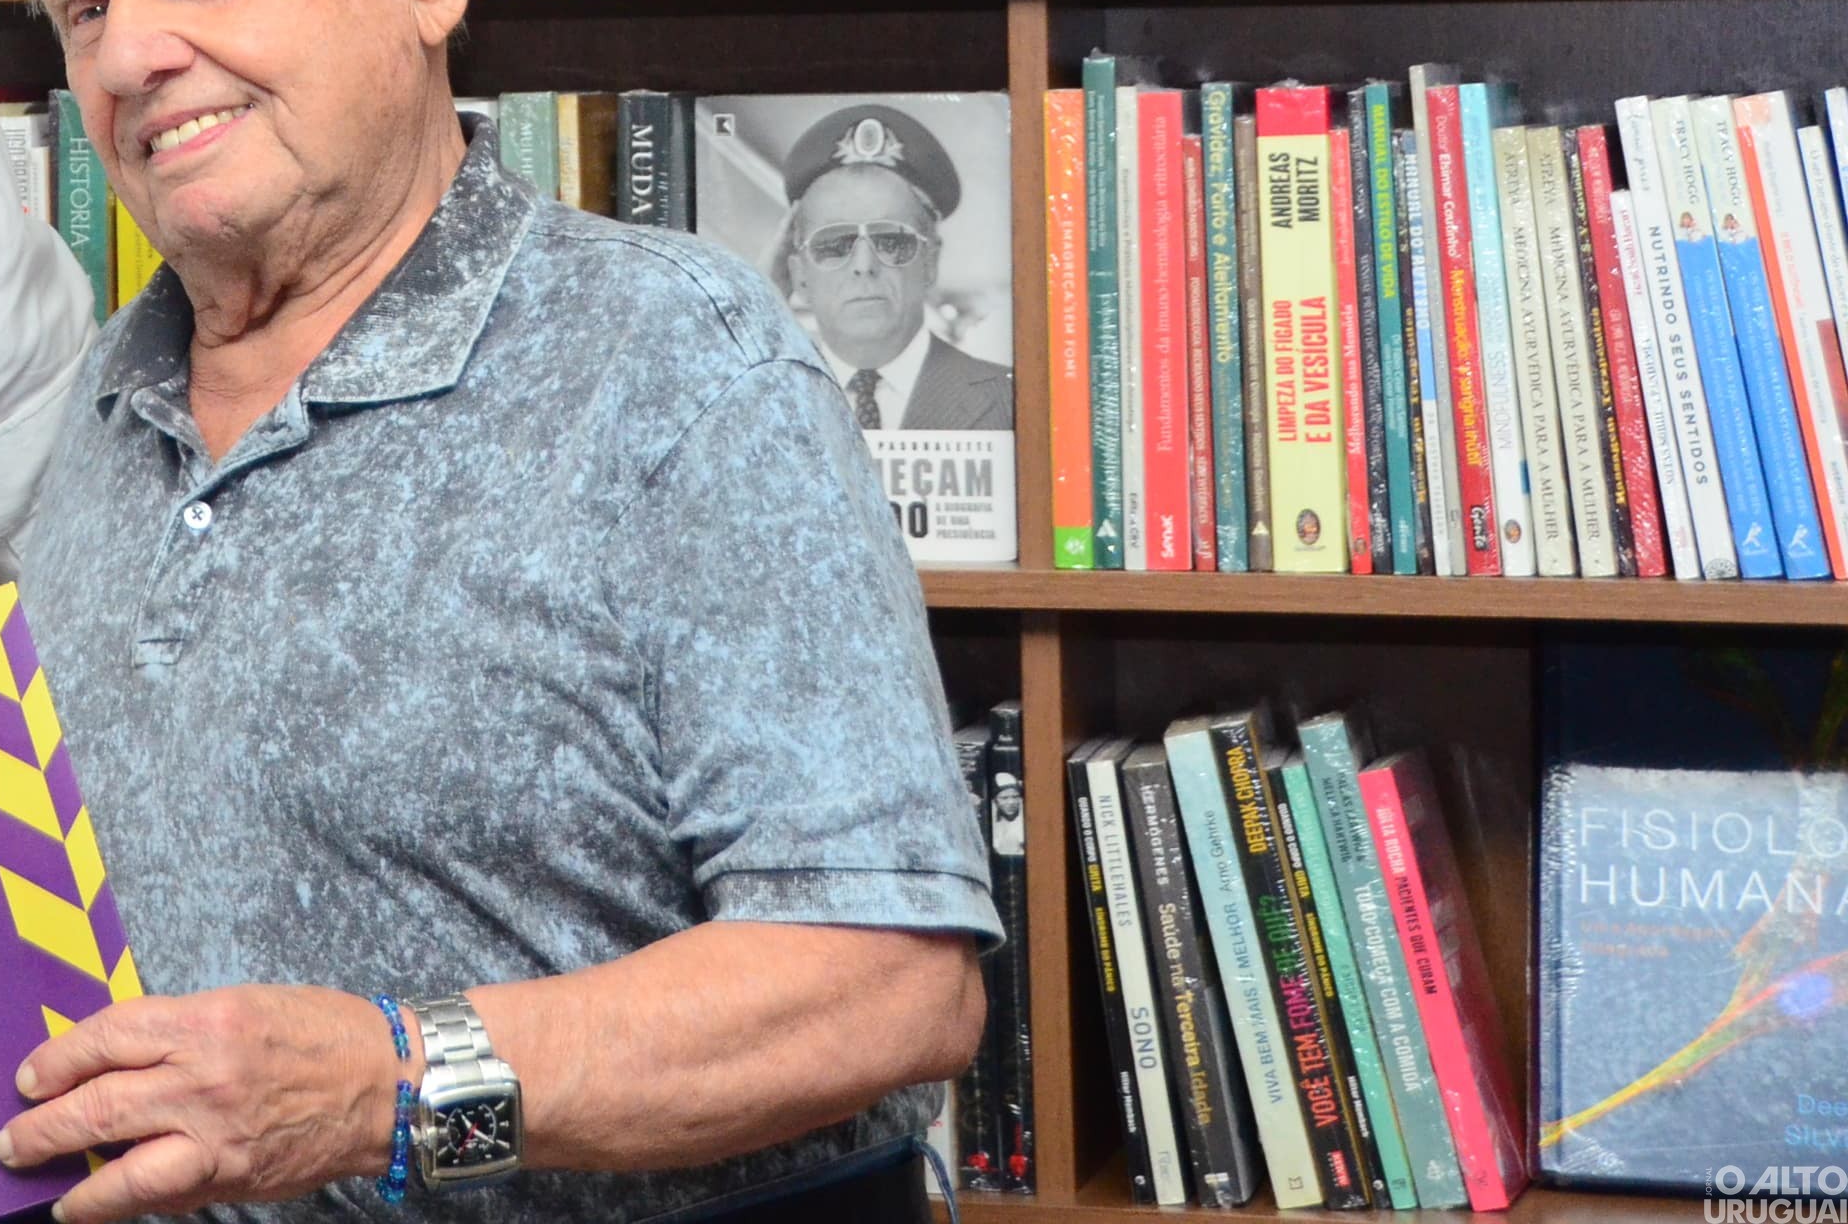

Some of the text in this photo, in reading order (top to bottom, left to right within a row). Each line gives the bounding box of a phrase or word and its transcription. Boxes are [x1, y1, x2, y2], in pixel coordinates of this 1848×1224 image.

[67, 136, 92, 248] HISTÓRIA
[630, 124, 654, 217] MUDA
[1268, 152, 1293, 229] ANDREAS
[1296, 157, 1321, 223] MORITZ
[1272, 300, 1297, 442] LIMPEZA DO FÍGADO
[1297, 296, 1332, 443] E DA VESÍCULA
[1648, 226, 1709, 487] NUTRINDO SEUS SENTIDOS
[1161, 514, 1176, 559] Senac
[1204, 810, 1232, 892] Arno Gehrke
[1226, 746, 1268, 854] DEEPAK CHOPRA
[1098, 794, 1131, 927] NICK LITTLEHALES
[1376, 806, 1438, 996] JÚLIA ROCHA PACIENTES QUE CURAM
[1130, 1006, 1157, 1070] SONO
[1158, 903, 1212, 1125] Saúde na Terceira Idade
